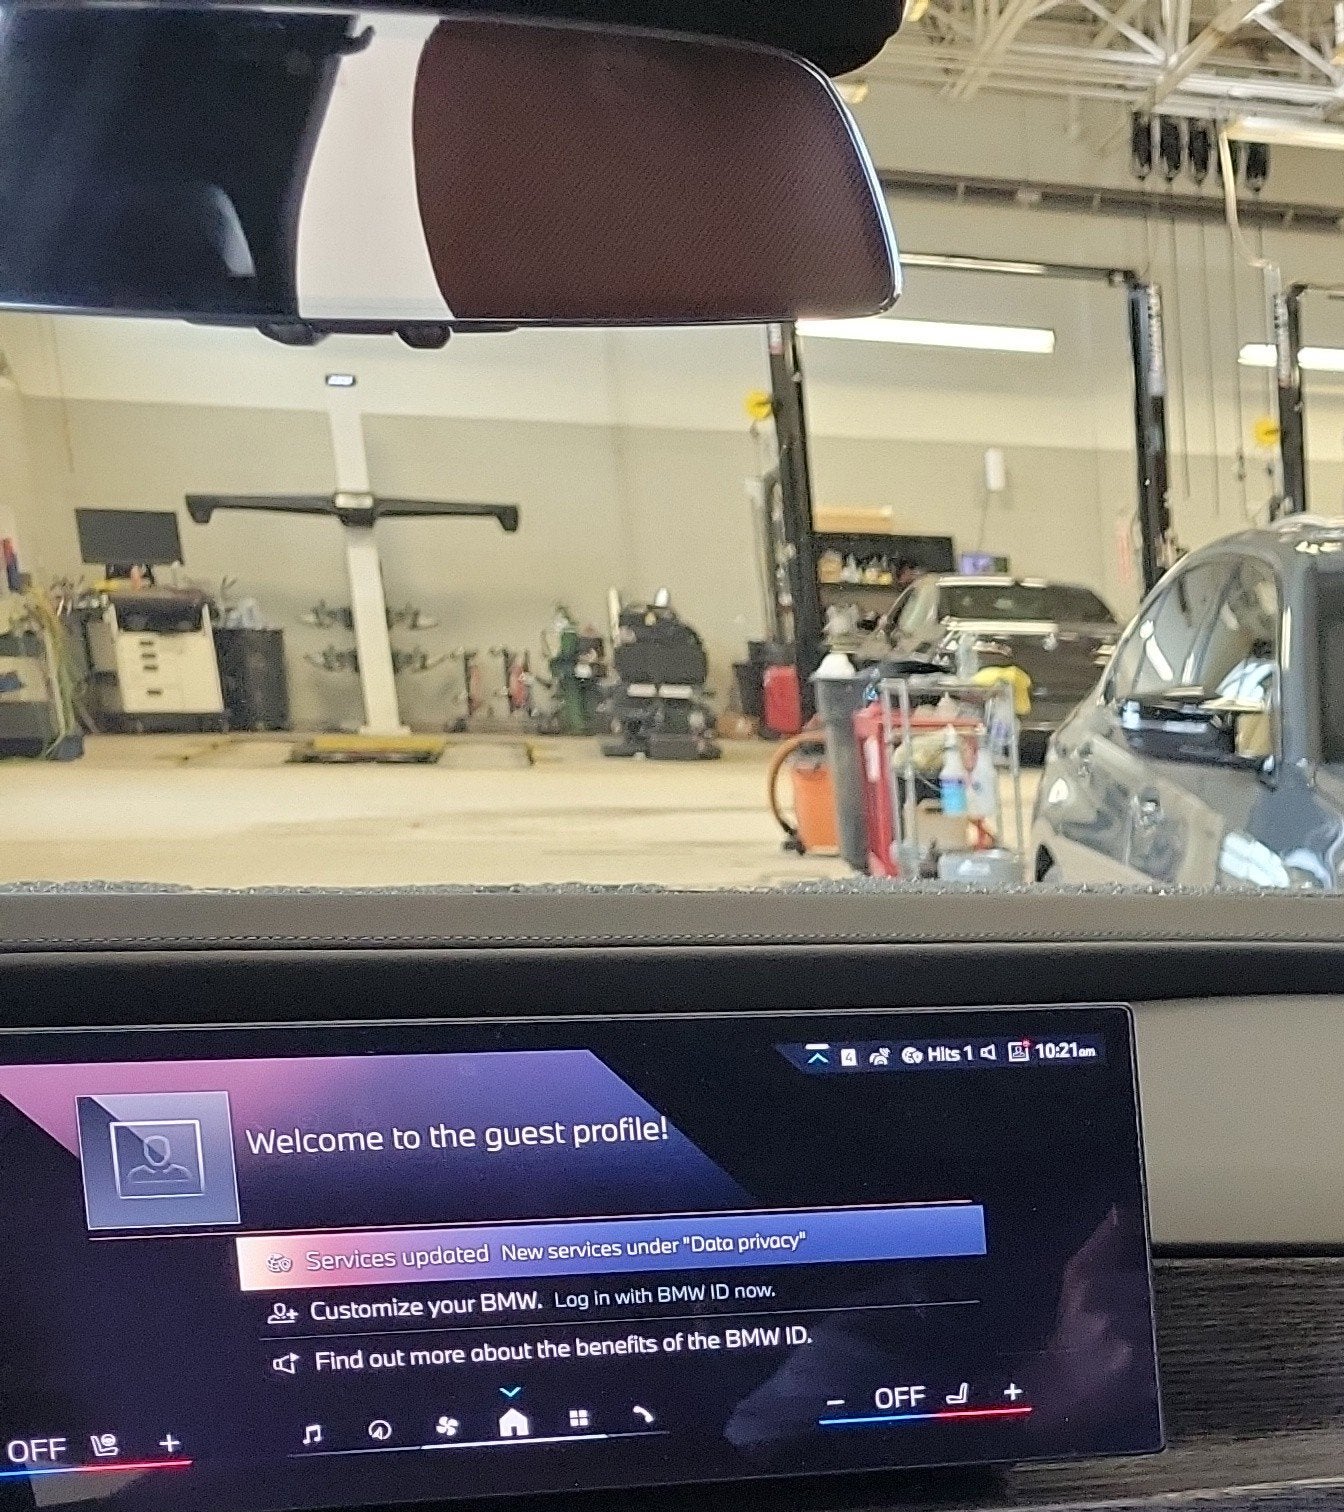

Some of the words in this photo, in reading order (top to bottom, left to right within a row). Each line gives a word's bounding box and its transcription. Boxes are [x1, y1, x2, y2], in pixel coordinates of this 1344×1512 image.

[928, 1046, 961, 1062] Hits
[964, 1045, 972, 1060] 1
[246, 1128, 384, 1155] Welcome
[392, 1128, 421, 1150] to
[428, 1124, 476, 1149] the
[485, 1123, 566, 1152] guest
[572, 1116, 670, 1148] profile!
[305, 1250, 397, 1271] Services
[402, 1245, 490, 1268] updated
[501, 1244, 544, 1261] New
[547, 1241, 622, 1259] services
[626, 1237, 680, 1256] under
[683, 1235, 734, 1252] "Data
[738, 1231, 806, 1253] privacy"
[310, 1300, 424, 1322] Customize
[428, 1298, 476, 1317] your
[480, 1292, 544, 1312] BMW.
[554, 1292, 589, 1310] Log
[594, 1290, 610, 1306] in
[615, 1288, 653, 1305] with
[657, 1284, 706, 1302] BMW
[710, 1283, 730, 1299] ID
[734, 1284, 776, 1299] now.
[315, 1351, 364, 1372] Find
[369, 1351, 404, 1367] out
[409, 1348, 465, 1365] more
[471, 1342, 531, 1361] about
[536, 1339, 570, 1358] the
[575, 1334, 658, 1356] benefits
[662, 1332, 684, 1352] of
[687, 1331, 721, 1350] the
[725, 1328, 780, 1348] BMW
[785, 1325, 813, 1345] ID.
[875, 1385, 926, 1409] OFF
[8, 1438, 67, 1462] OFF
